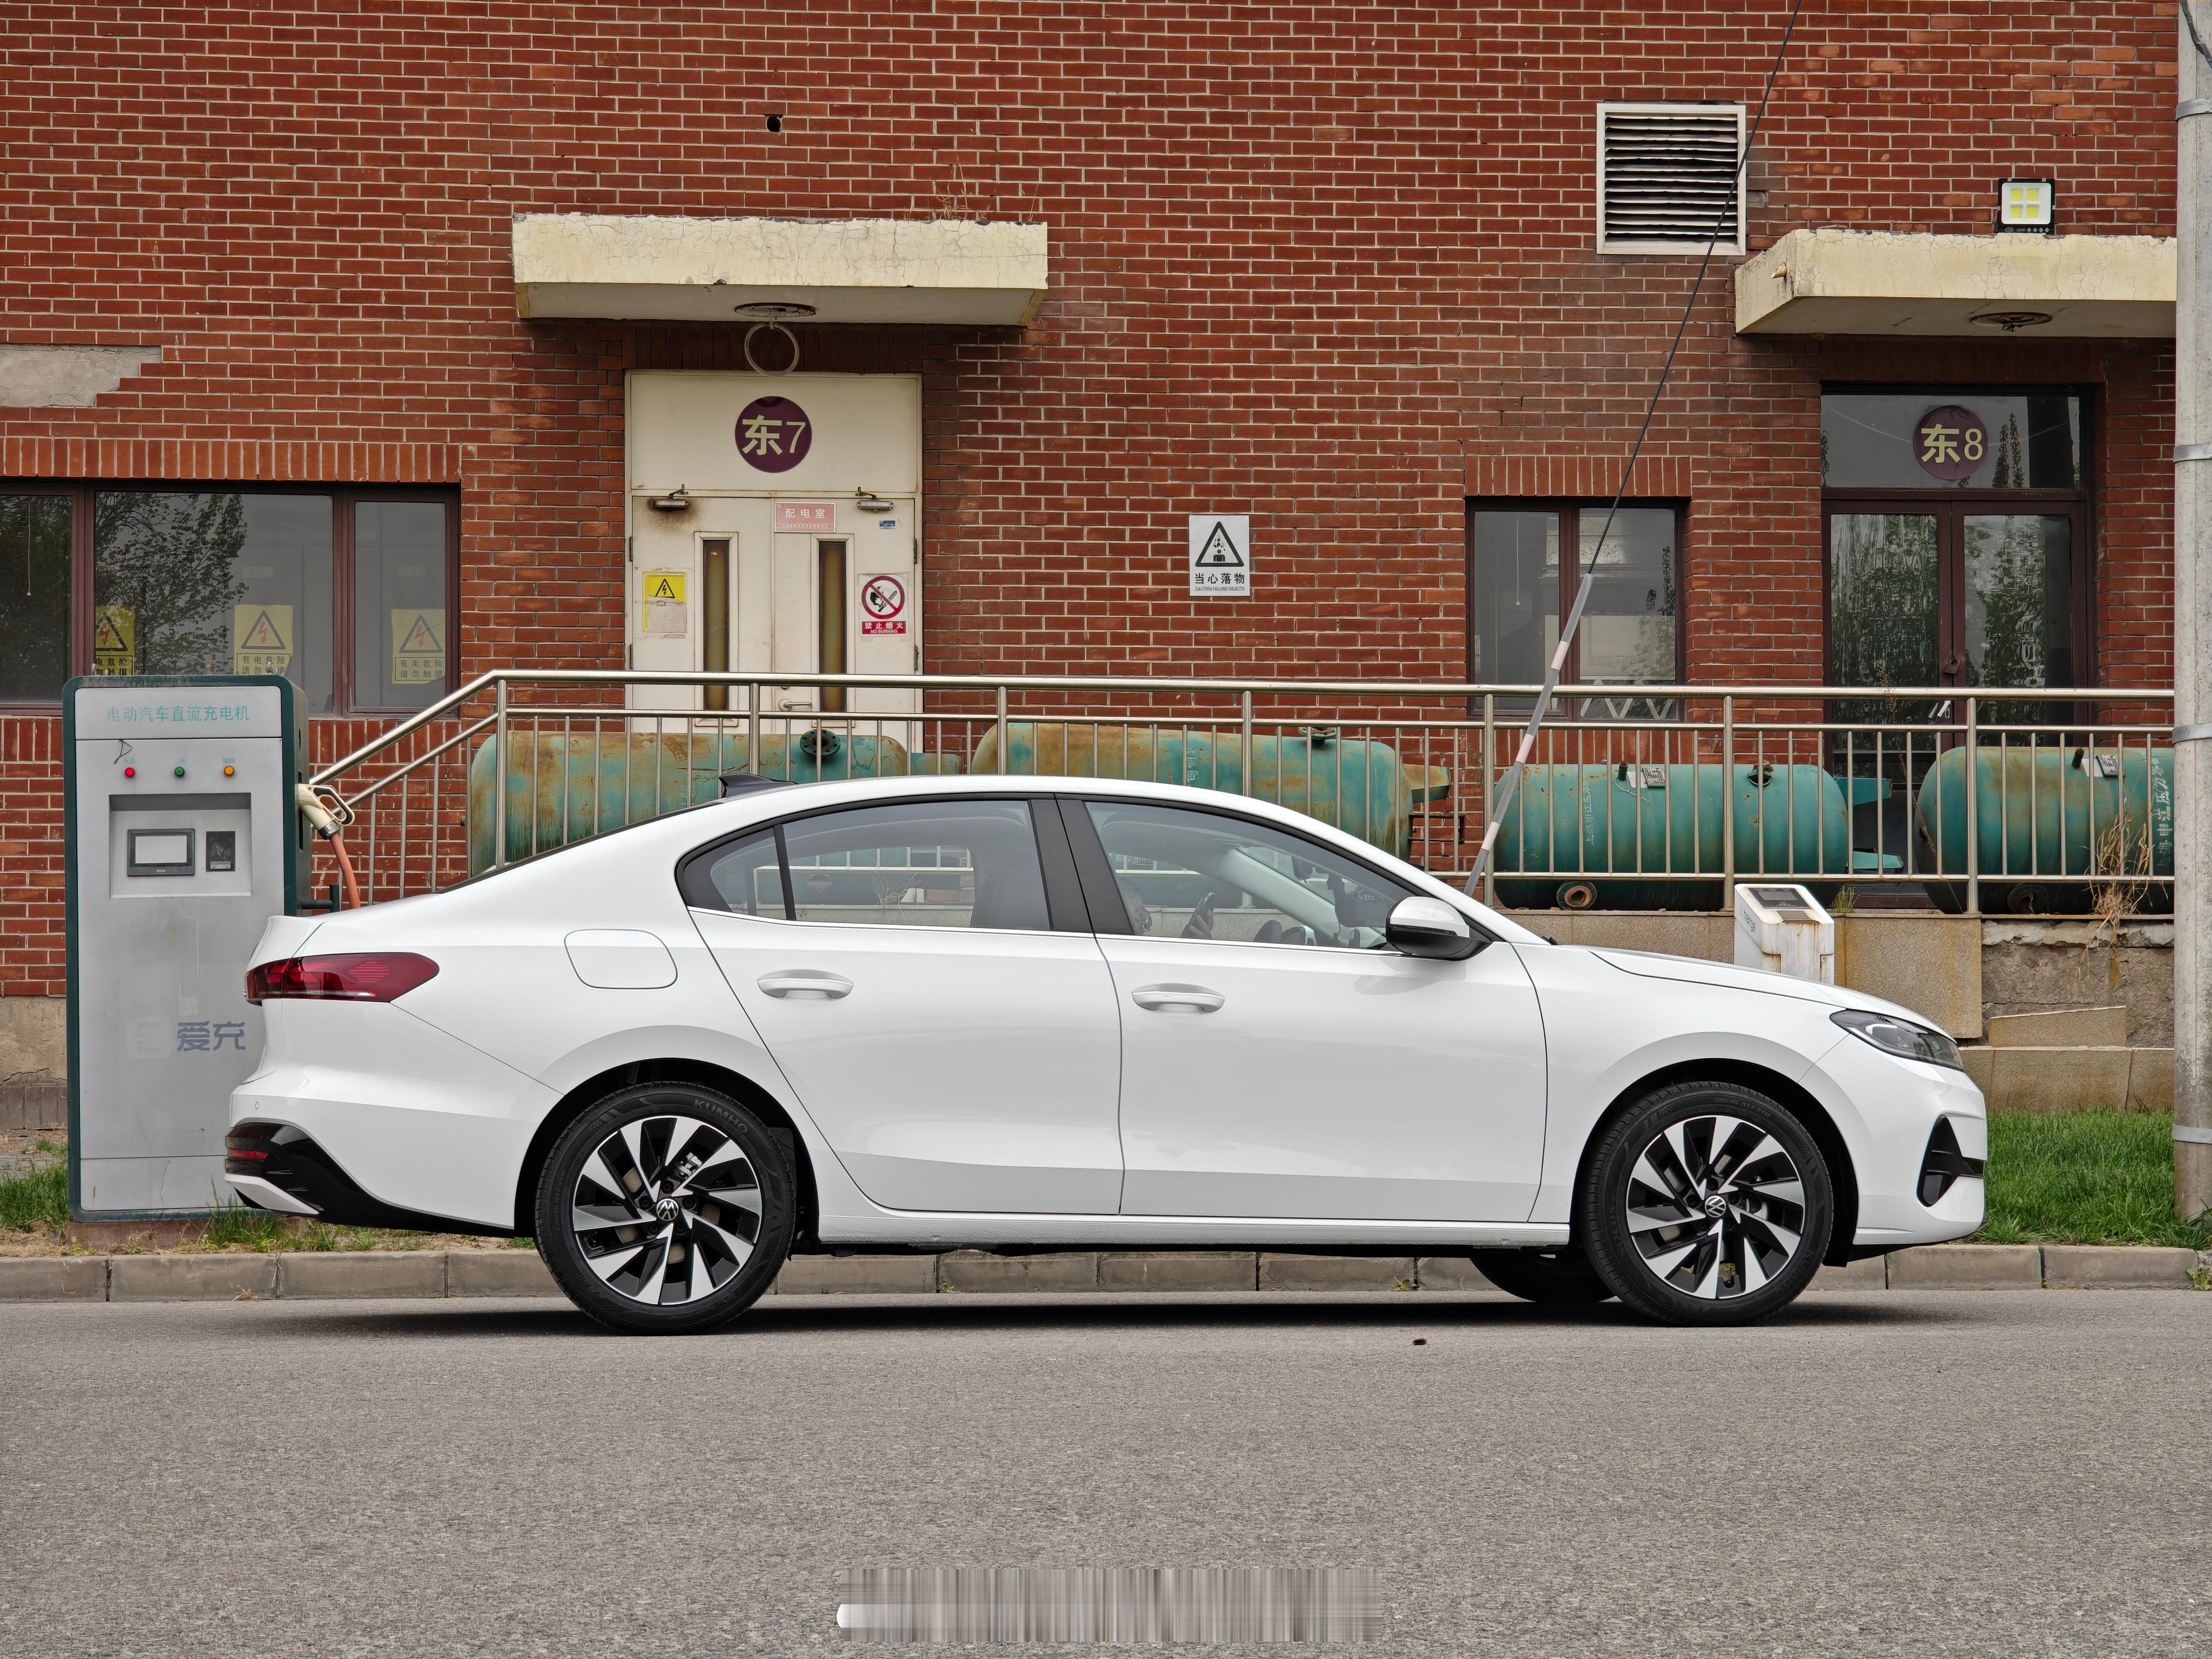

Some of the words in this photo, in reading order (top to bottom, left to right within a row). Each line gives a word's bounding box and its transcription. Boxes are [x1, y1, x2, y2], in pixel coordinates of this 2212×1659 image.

[741, 415, 806, 455] 东7
[1920, 423, 1983, 464] 东8
[785, 508, 825, 519] 配电室
[1195, 573, 1245, 584] 当心落物
[242, 656, 286, 664] 有电危险
[400, 659, 443, 667] 有电危险
[108, 705, 249, 721] 电动汽车直流充电机
[177, 1021, 246, 1051] 爱充
[693, 1098, 749, 1135] KUMHO
